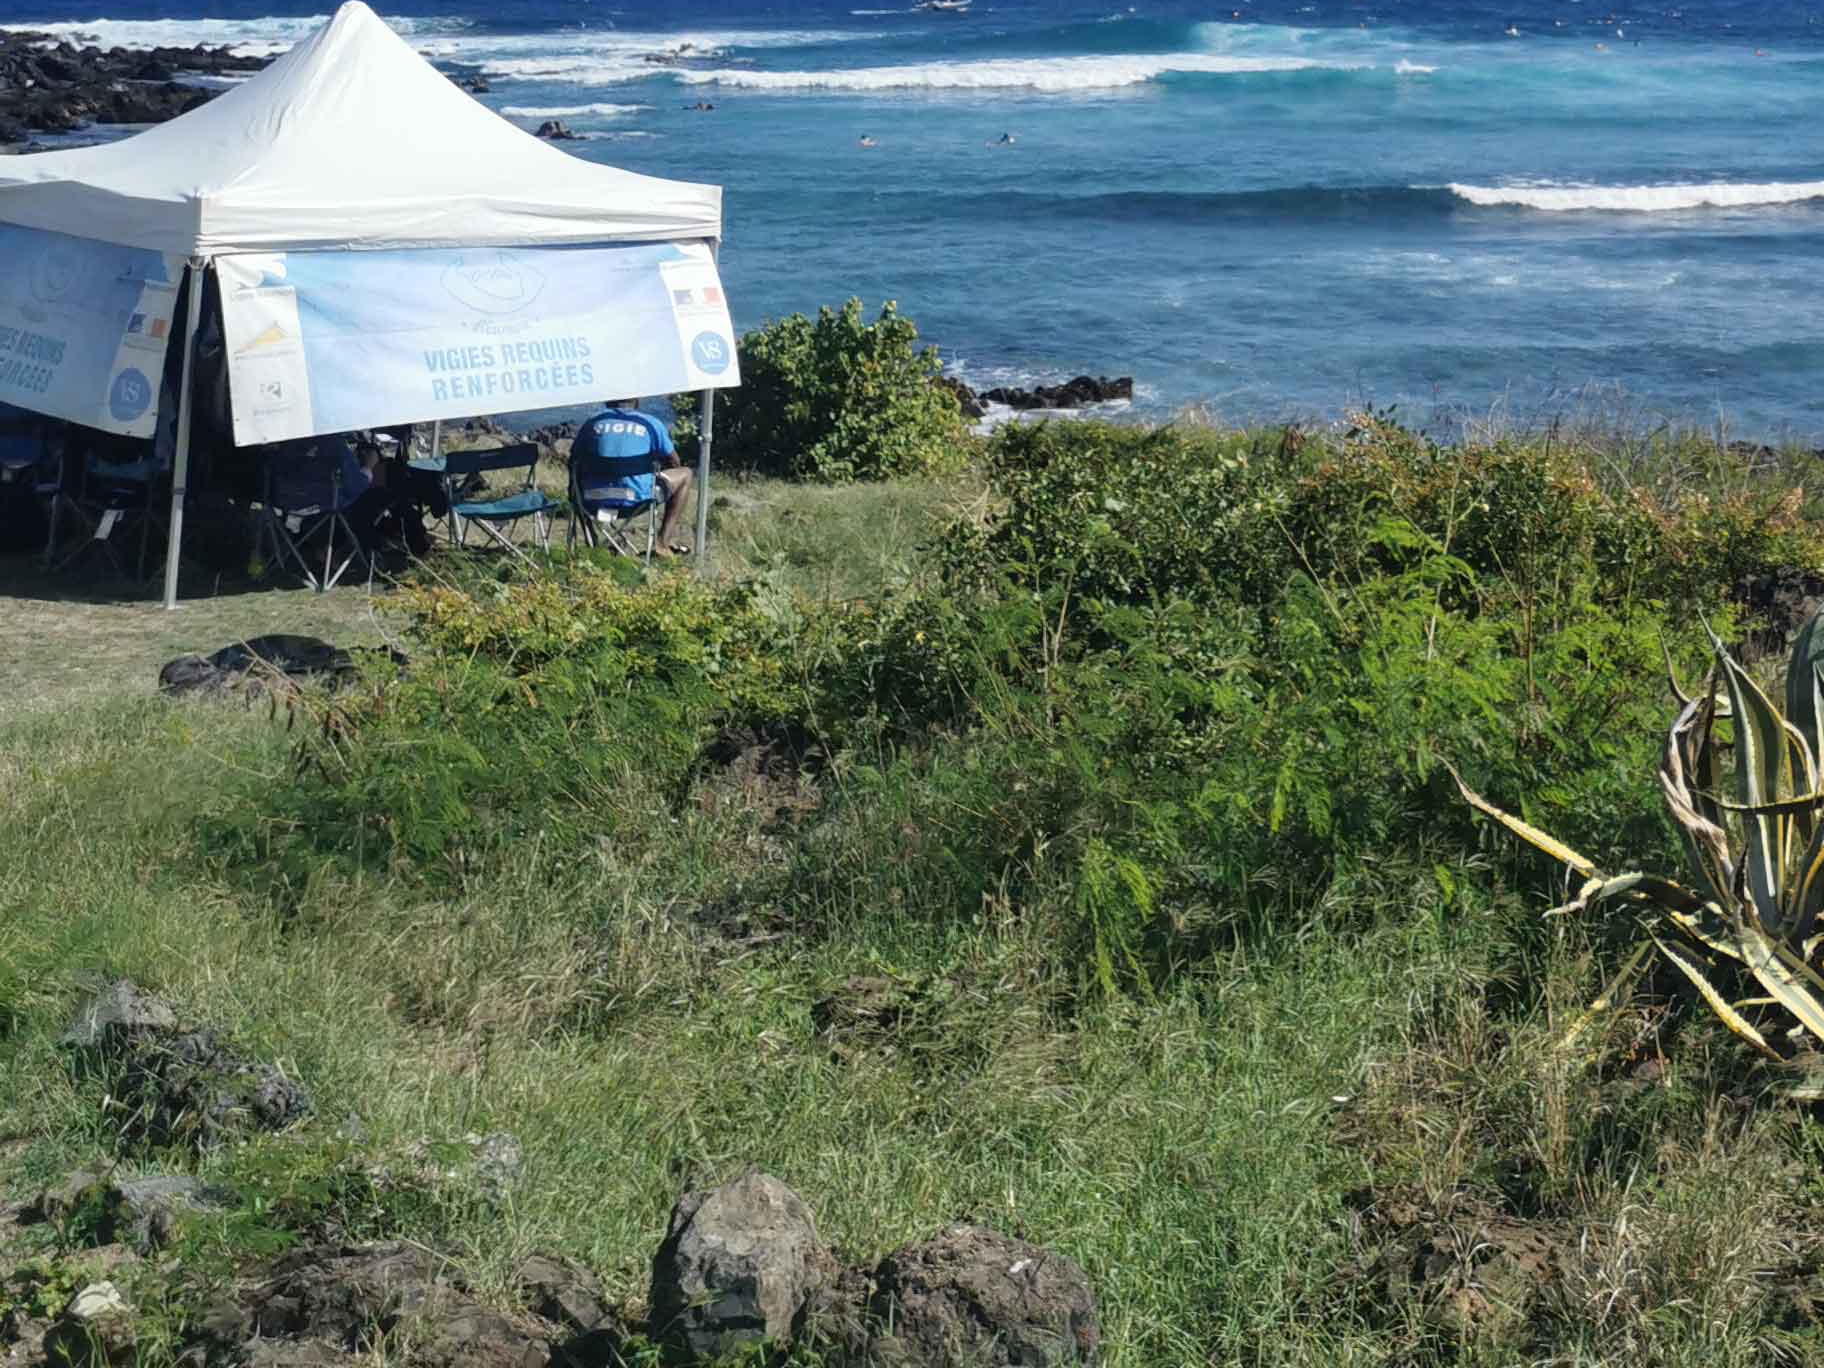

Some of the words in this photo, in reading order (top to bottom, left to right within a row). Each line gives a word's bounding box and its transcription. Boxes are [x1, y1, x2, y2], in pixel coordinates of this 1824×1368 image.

[424, 344, 495, 372] VIGIES
[501, 336, 592, 366] REQUINS
[432, 361, 593, 400] RENFORCÉES
